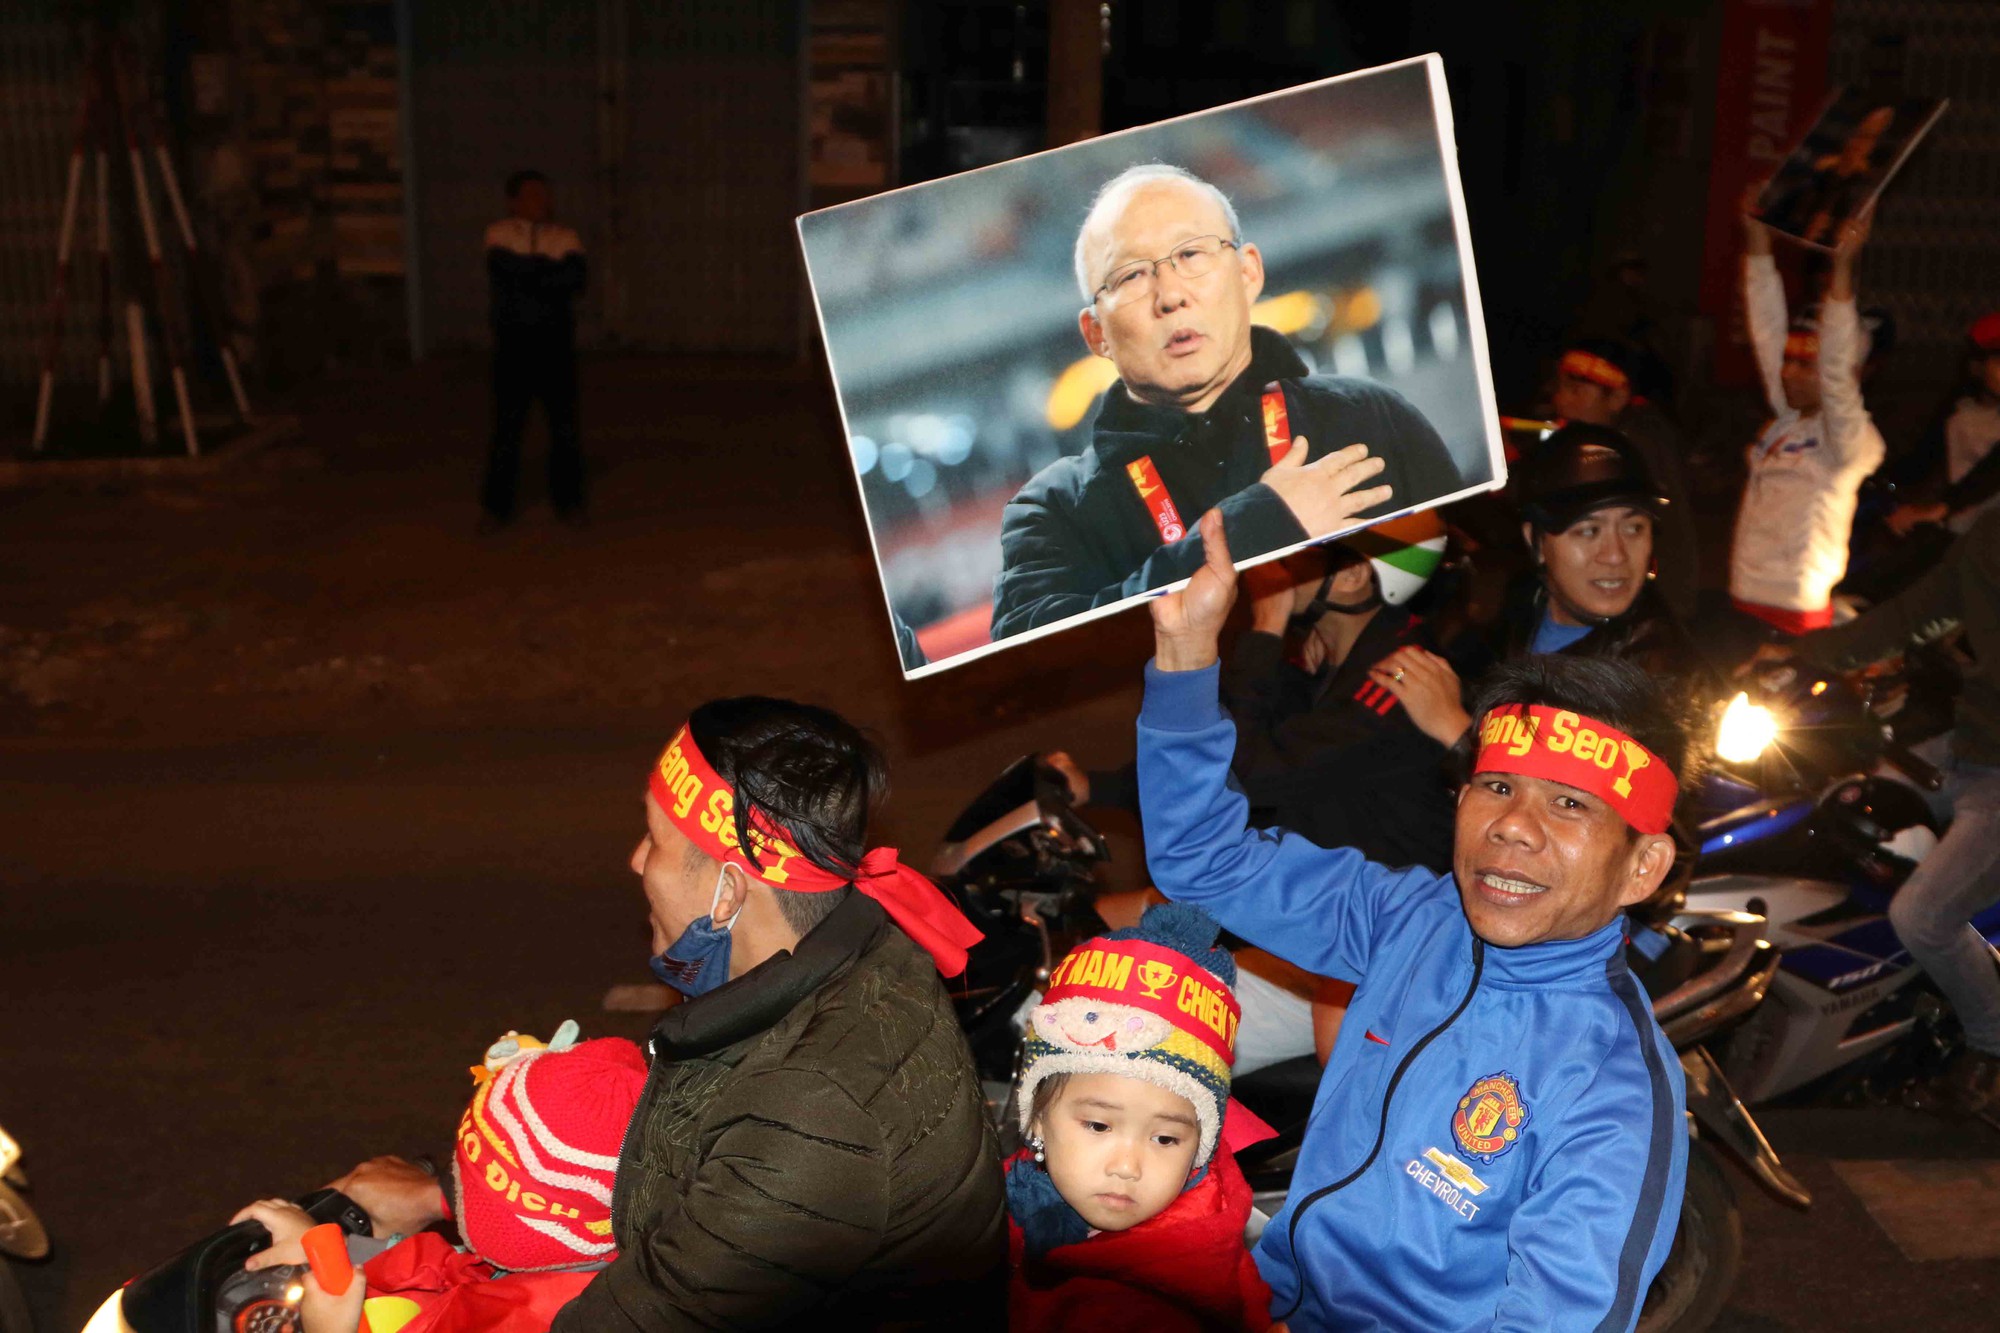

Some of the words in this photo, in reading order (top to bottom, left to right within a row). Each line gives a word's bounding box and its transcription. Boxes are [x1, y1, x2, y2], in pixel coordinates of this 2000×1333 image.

[1748, 26, 1795, 161] PAINT
[1546, 710, 1620, 770] Seo
[700, 788, 766, 858] Seo
[1063, 949, 1135, 992] NAM
[1474, 1082, 1517, 1121] MANCHESTER
[1458, 1123, 1492, 1149] UNITED
[1405, 1159, 1481, 1222] CHEVROLET
